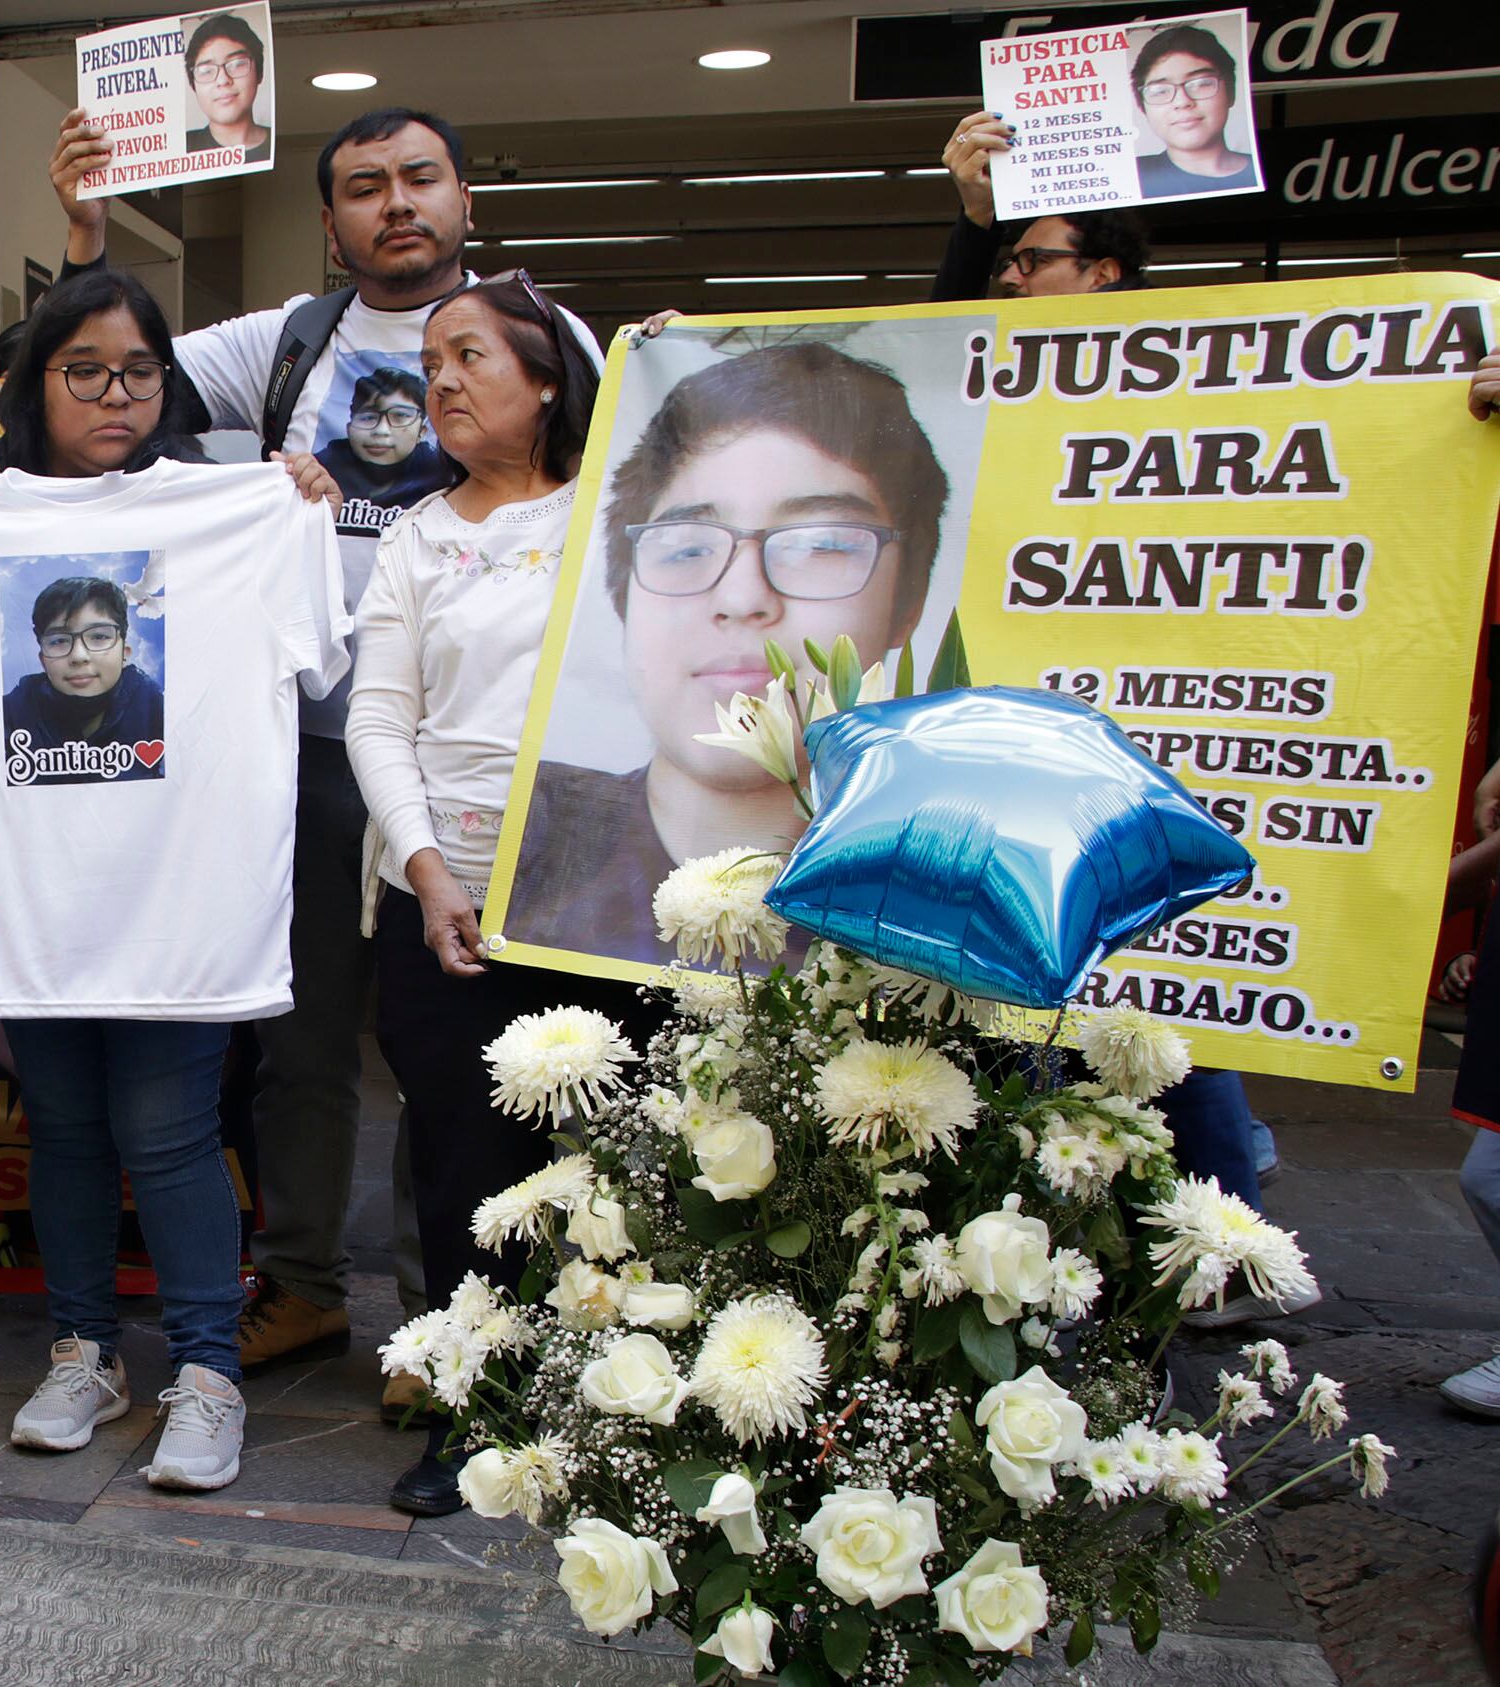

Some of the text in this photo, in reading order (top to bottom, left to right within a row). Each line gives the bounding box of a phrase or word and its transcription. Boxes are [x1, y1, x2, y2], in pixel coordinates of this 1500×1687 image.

[82, 31, 184, 73] PRESIDENTE
[990, 31, 1129, 65] ¡JUSTICIA
[97, 68, 168, 99] RIVERA..
[1023, 60, 1097, 85] PARA
[1014, 82, 1107, 110] SANTI!
[1024, 111, 1102, 129] 12 MESES
[1028, 126, 1132, 146] RESPUESTA..
[116, 133, 167, 156] FAVOR!
[1011, 143, 1122, 164] 12 MESES SIN
[83, 148, 243, 188] SIN INTERMEDIARIOS
[1031, 162, 1104, 178] MI HIJO..
[1031, 176, 1110, 194] 12 MESES
[1012, 190, 1132, 211] SIN TRABAJO...
[966, 306, 1488, 400] ¡JUSTICIA
[1058, 428, 1340, 499] PARA
[1009, 542, 1366, 613] SANTI!
[1116, 672, 1327, 716] MESES
[7, 730, 134, 784] Santiago
[1265, 802, 1373, 846] SIN
[1124, 919, 1290, 967] ESES
[1080, 971, 1352, 1041] RABAJO...
